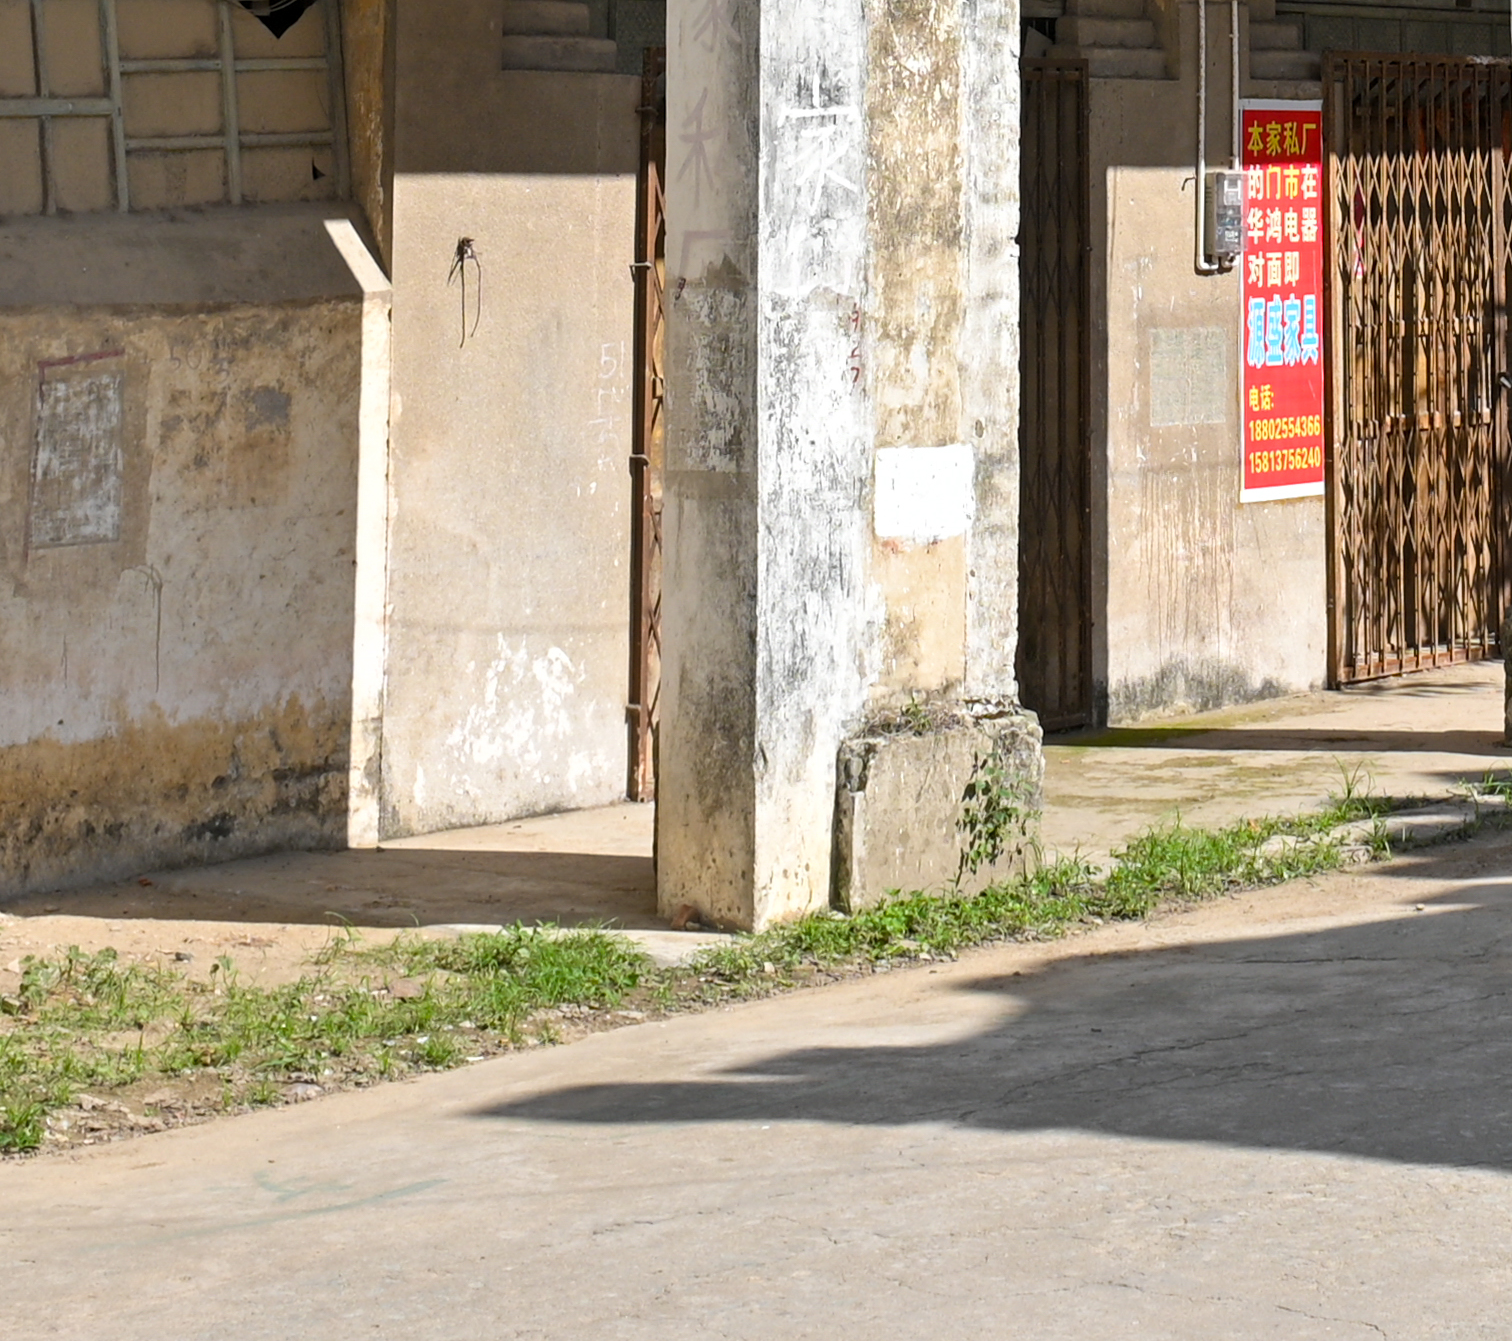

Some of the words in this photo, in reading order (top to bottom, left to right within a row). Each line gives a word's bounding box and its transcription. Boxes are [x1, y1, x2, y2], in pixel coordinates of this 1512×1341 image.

[1247, 119, 1317, 157] 本家私厂
[1247, 163, 1319, 200] 的门市在
[1247, 206, 1318, 245] 华鸿电器
[1247, 250, 1301, 288] 对面即
[1247, 293, 1319, 369] 源盛家具
[1249, 414, 1321, 442] 18802554366
[1249, 446, 1321, 474] 15813756240
